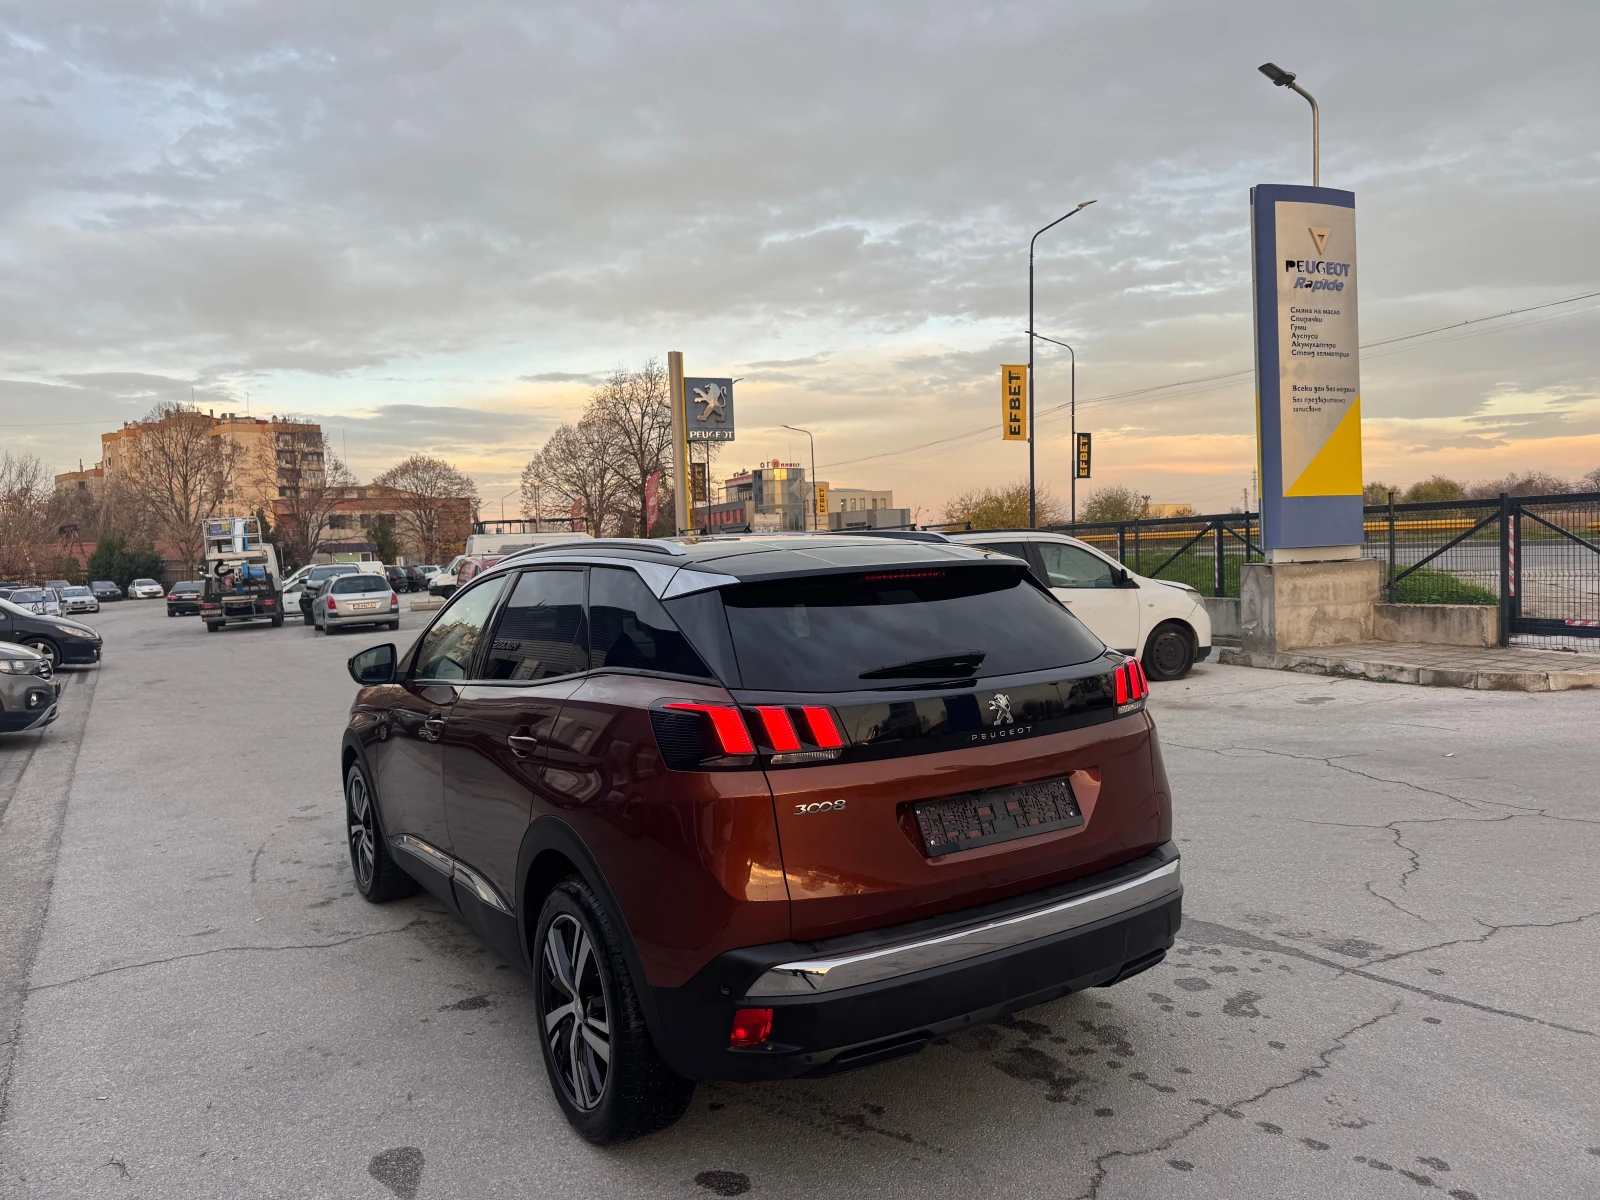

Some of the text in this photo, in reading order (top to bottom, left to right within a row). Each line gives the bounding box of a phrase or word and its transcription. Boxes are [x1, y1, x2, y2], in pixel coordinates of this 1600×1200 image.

[1285, 260, 1350, 277] PEUGEOT
[1293, 276, 1345, 292] Rapide
[1290, 306, 1313, 314] Смяна
[1290, 323, 1307, 332] Гуми
[1008, 370, 1021, 436] EFBET
[689, 430, 734, 439] PEUGEOT
[1080, 436, 1089, 476] EFBET
[971, 725, 1033, 741] PEUGEOT
[793, 799, 847, 816] 3008
